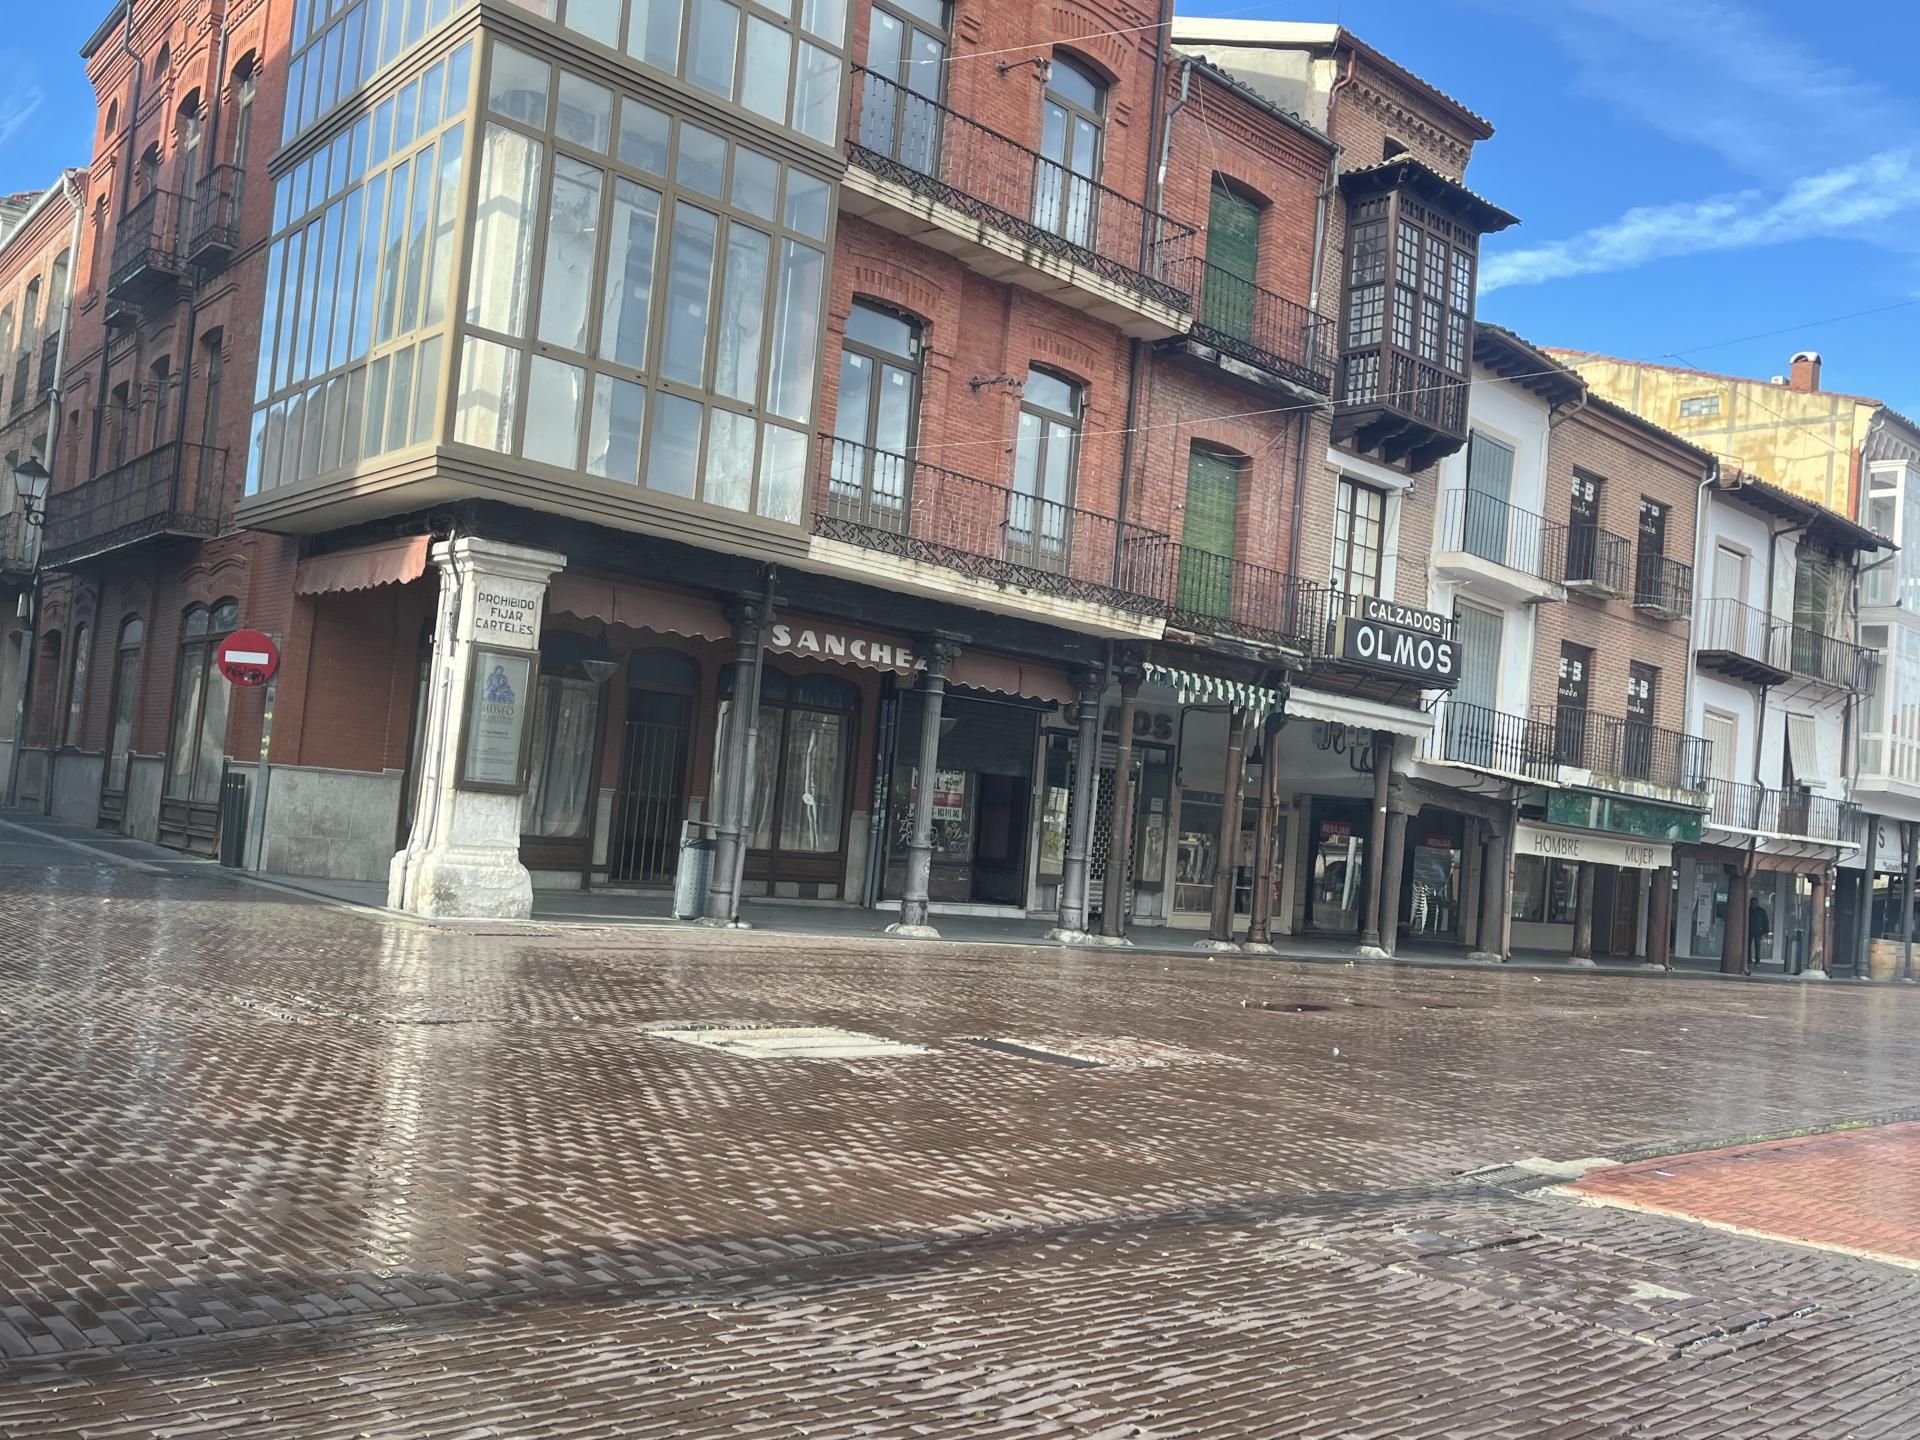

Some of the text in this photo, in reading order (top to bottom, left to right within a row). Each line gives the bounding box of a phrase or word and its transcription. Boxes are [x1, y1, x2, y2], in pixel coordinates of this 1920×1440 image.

[478, 592, 535, 610] PROHIBIDO
[490, 607, 523, 621] FIJAR
[1369, 601, 1441, 632] CALZADOS
[475, 617, 533, 635] CARTELES
[1357, 626, 1452, 674] OLMOS
[1535, 834, 1579, 857] HOMBRE
[1625, 845, 1654, 866] MUJER
